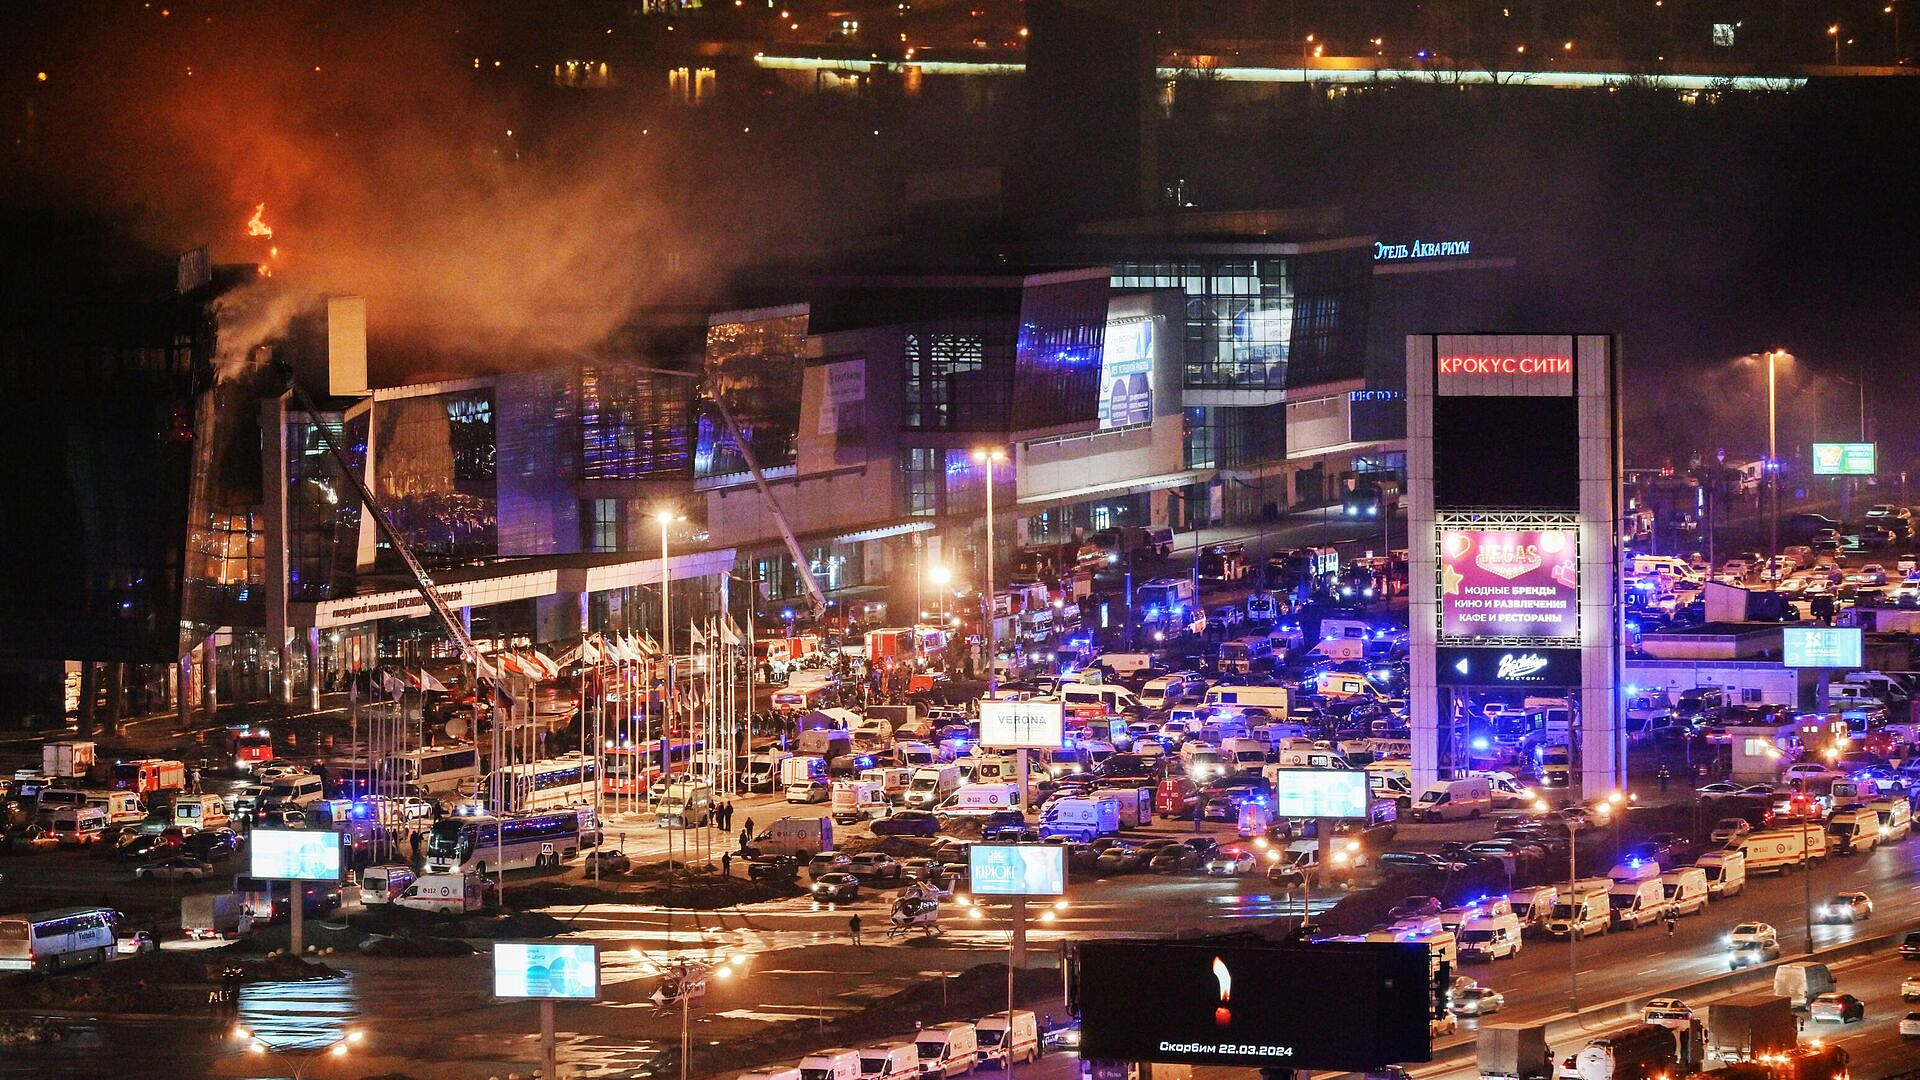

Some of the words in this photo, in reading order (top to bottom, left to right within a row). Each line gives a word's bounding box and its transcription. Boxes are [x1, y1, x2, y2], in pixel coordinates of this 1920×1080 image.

[1411, 239, 1470, 257] АКВАРИУМ
[1440, 358, 1516, 373] КРОКУС
[1519, 358, 1571, 373] СИТИ
[1479, 544, 1538, 564] VEGAS
[1464, 586, 1510, 596] МОДНЫЕ
[1512, 586, 1556, 597] БРЕНДЫ
[1454, 599, 1483, 608] КИНО
[1484, 599, 1493, 608] И
[1494, 599, 1567, 609] РАЗВЛЕЧЕНИЯ
[1459, 613, 1487, 622] КАФЕ
[1488, 613, 1497, 622] И
[1498, 613, 1562, 623] РЕСТОРАНЫ
[997, 715, 1047, 725] VERONA
[1160, 1042, 1216, 1053] Скорбим
[1219, 1045, 1293, 1056] 22.03.2024
